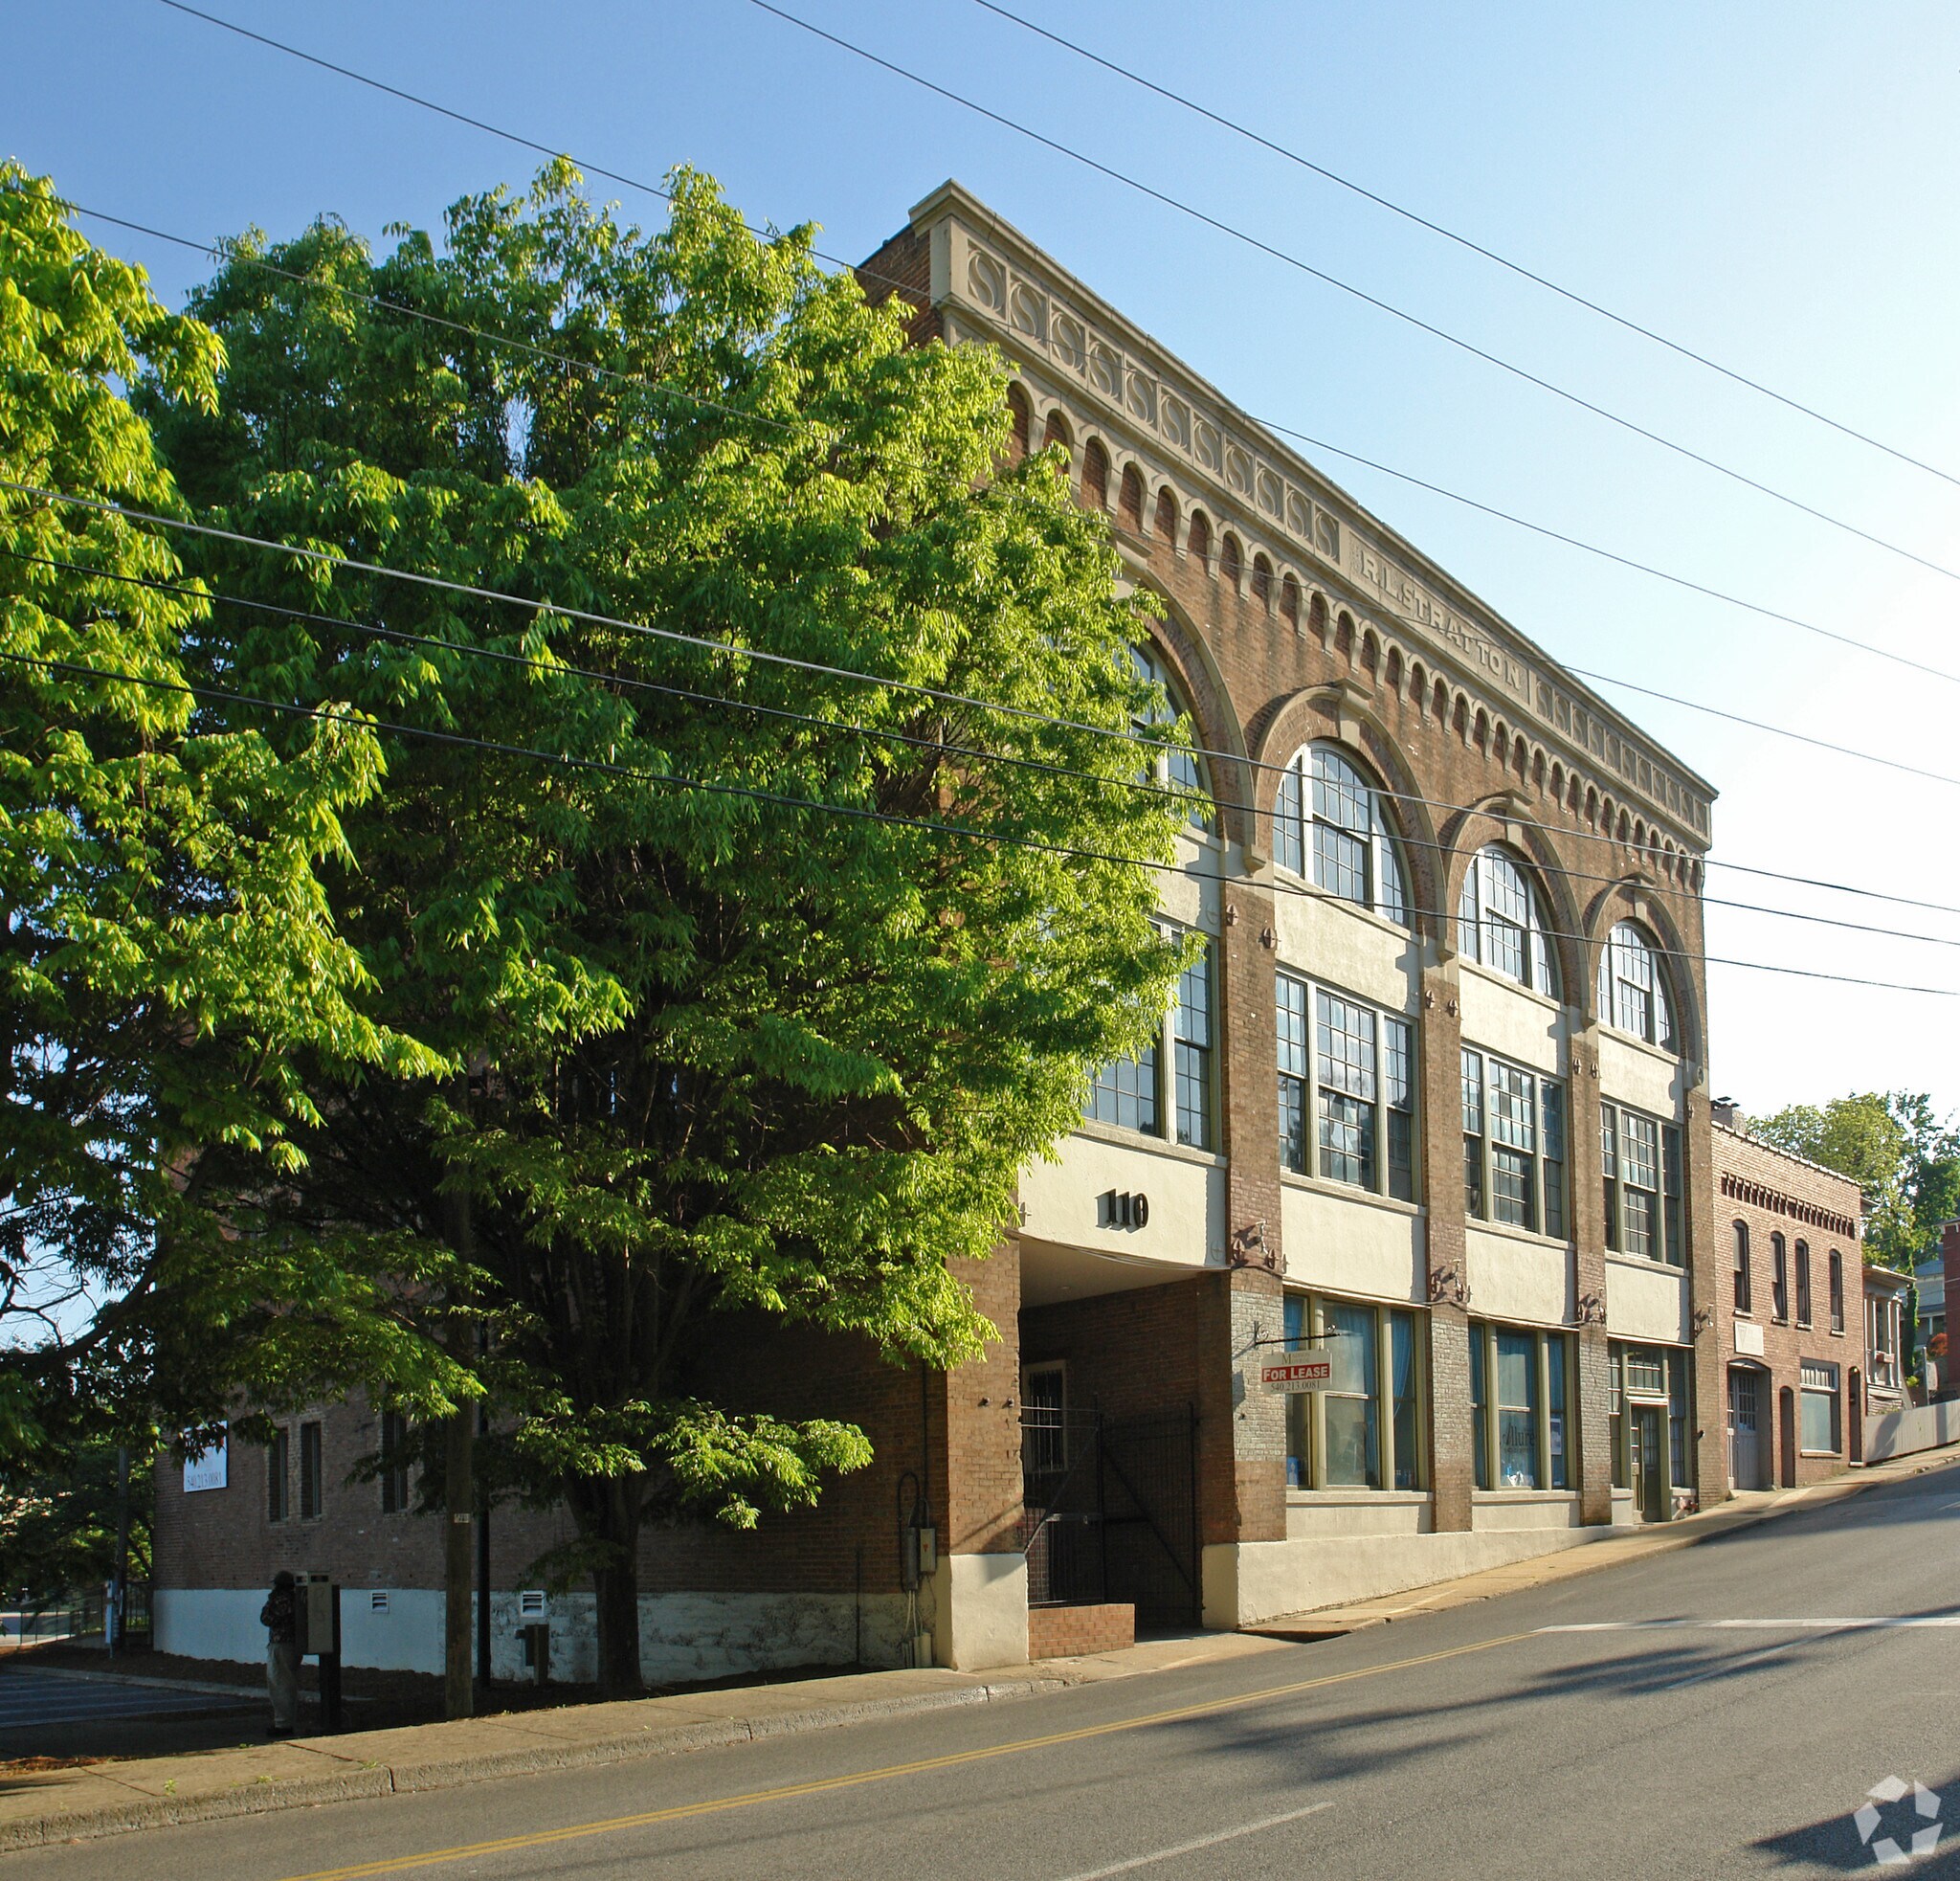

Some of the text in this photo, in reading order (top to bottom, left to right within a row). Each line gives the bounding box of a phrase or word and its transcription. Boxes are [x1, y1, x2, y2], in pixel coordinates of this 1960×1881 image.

[1099, 1188, 1149, 1231] 110
[1263, 1365, 1328, 1381] FOR LEASE
[1502, 1422, 1535, 1446] Allure
